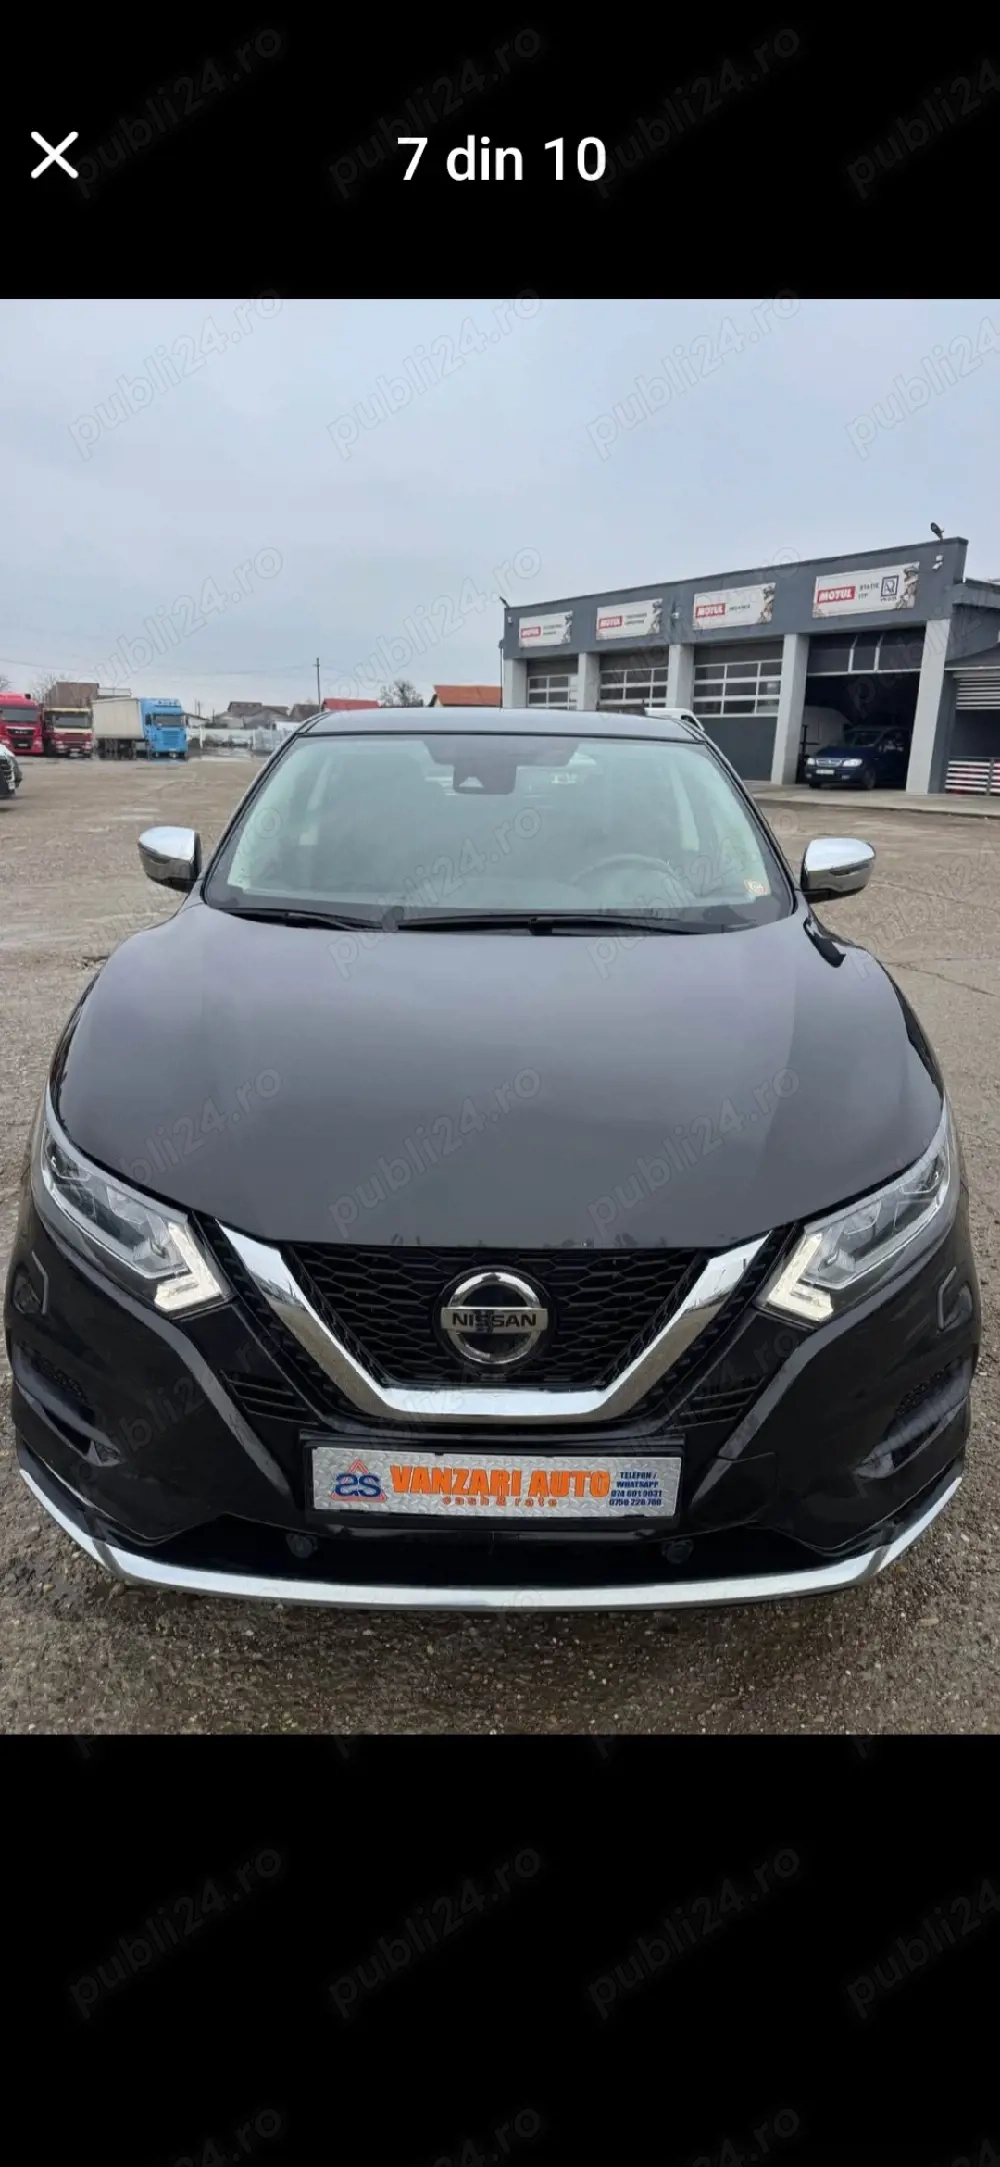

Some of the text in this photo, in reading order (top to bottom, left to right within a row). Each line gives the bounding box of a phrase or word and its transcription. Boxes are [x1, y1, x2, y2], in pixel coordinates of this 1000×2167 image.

[452, 1313, 537, 1328] NISSAN
[620, 1471, 652, 1479] TELEFON
[389, 1464, 611, 1498] VANZARI AUTO
[616, 1480, 659, 1488] WHATSAPP
